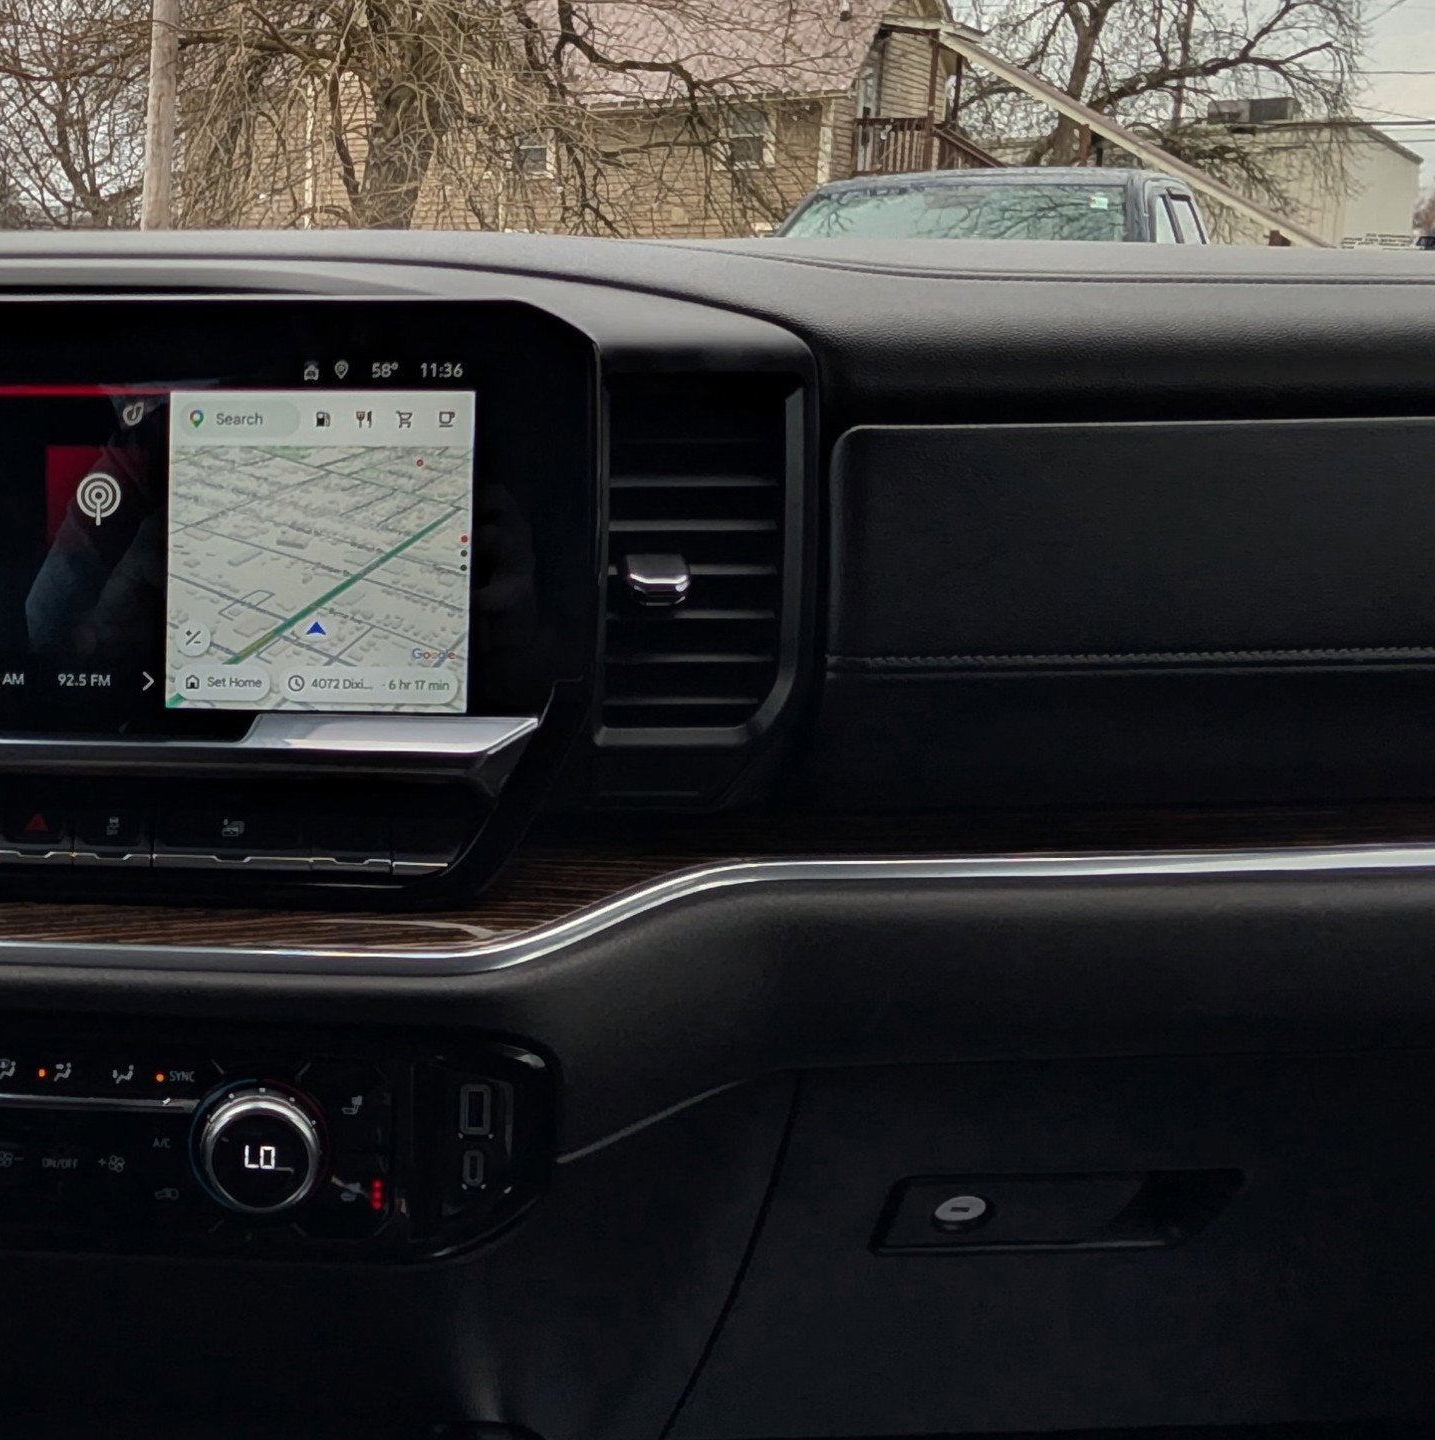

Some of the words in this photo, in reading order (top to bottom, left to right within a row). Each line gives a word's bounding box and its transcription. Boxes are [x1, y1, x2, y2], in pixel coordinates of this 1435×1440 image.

[420, 362, 464, 379] 11:36
[215, 411, 264, 428] Search
[1, 670, 26, 686] AM
[56, 672, 86, 687] 92.5
[88, 672, 112, 688] FM
[206, 675, 228, 691] Set
[229, 675, 263, 691] Home
[310, 677, 341, 692] 4072
[398, 677, 414, 692] hr
[427, 678, 450, 692] min
[168, 1069, 197, 1084] SYNC
[151, 1137, 172, 1150] A/C
[40, 1157, 80, 1170] ON/OFF
[243, 1144, 276, 1170] LO
